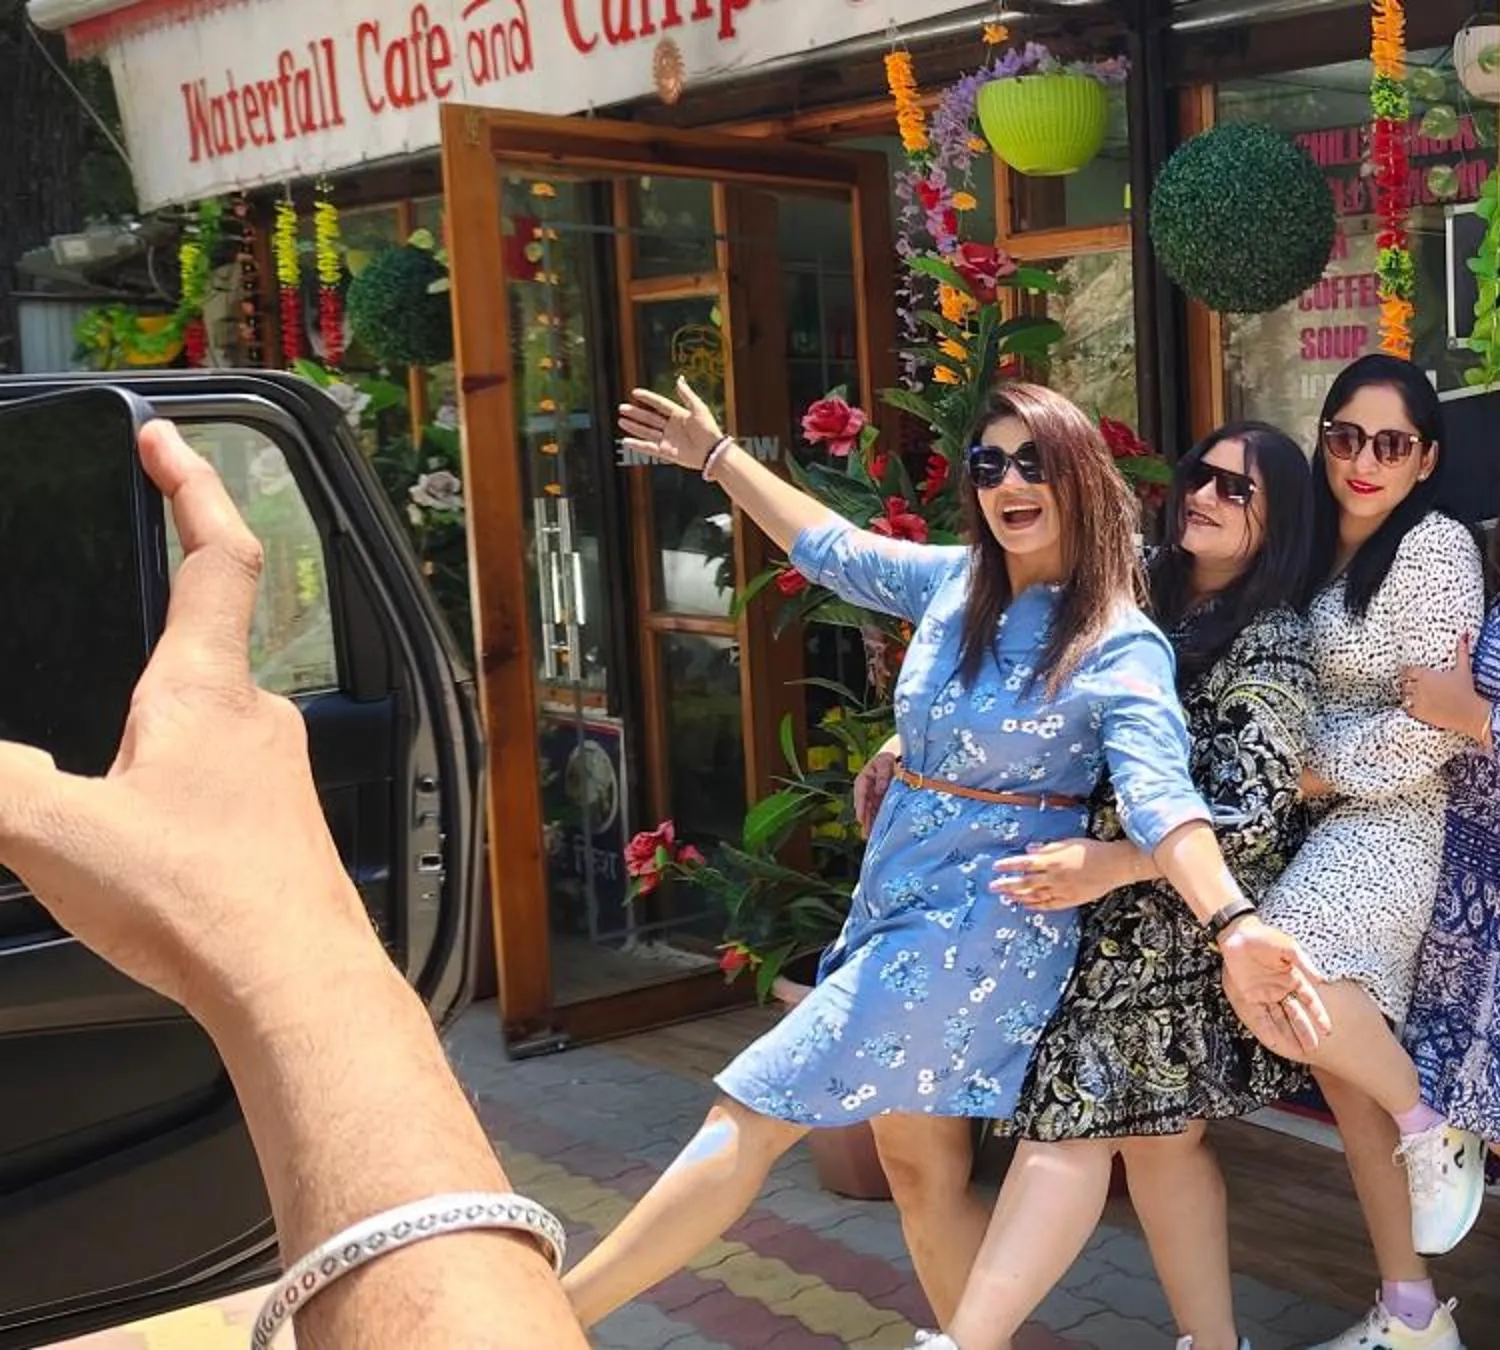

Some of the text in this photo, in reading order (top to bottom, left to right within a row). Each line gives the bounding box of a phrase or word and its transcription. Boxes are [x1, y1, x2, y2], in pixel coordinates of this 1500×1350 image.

[181, 38, 345, 163] Waterfall
[356, 3, 453, 115] Cafe
[467, 0, 535, 86] and
[1300, 324, 1368, 361] SOUP
